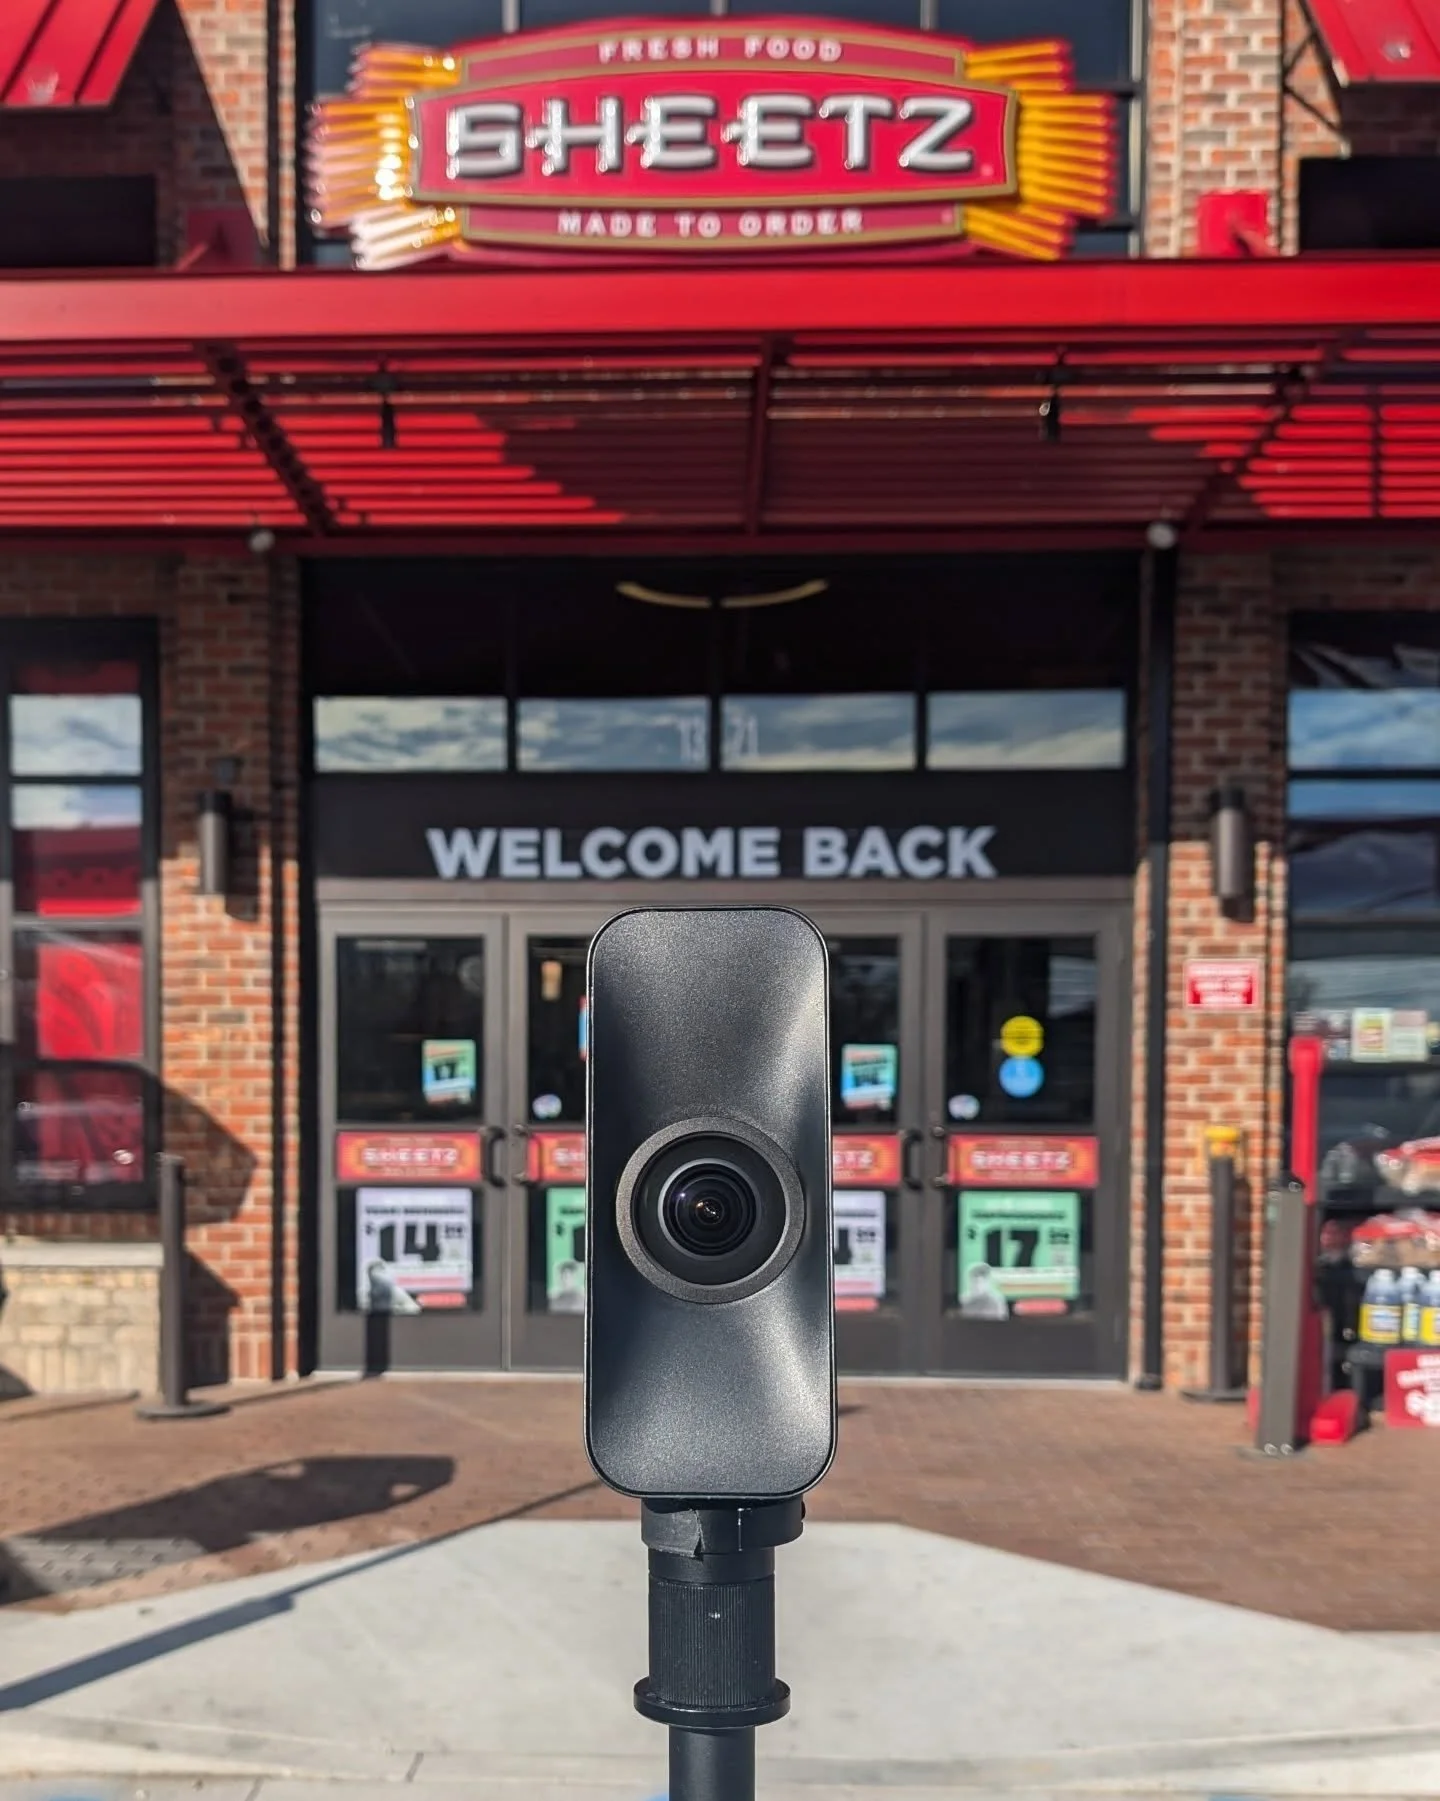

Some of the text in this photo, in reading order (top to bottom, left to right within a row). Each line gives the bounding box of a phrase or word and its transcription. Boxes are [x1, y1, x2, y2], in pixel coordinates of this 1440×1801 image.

[598, 35, 842, 64] FRESH FOOD
[445, 95, 973, 178] SHEETZ
[557, 208, 862, 238] MADE TO ORDER
[426, 825, 997, 880] WELCOME BACK
